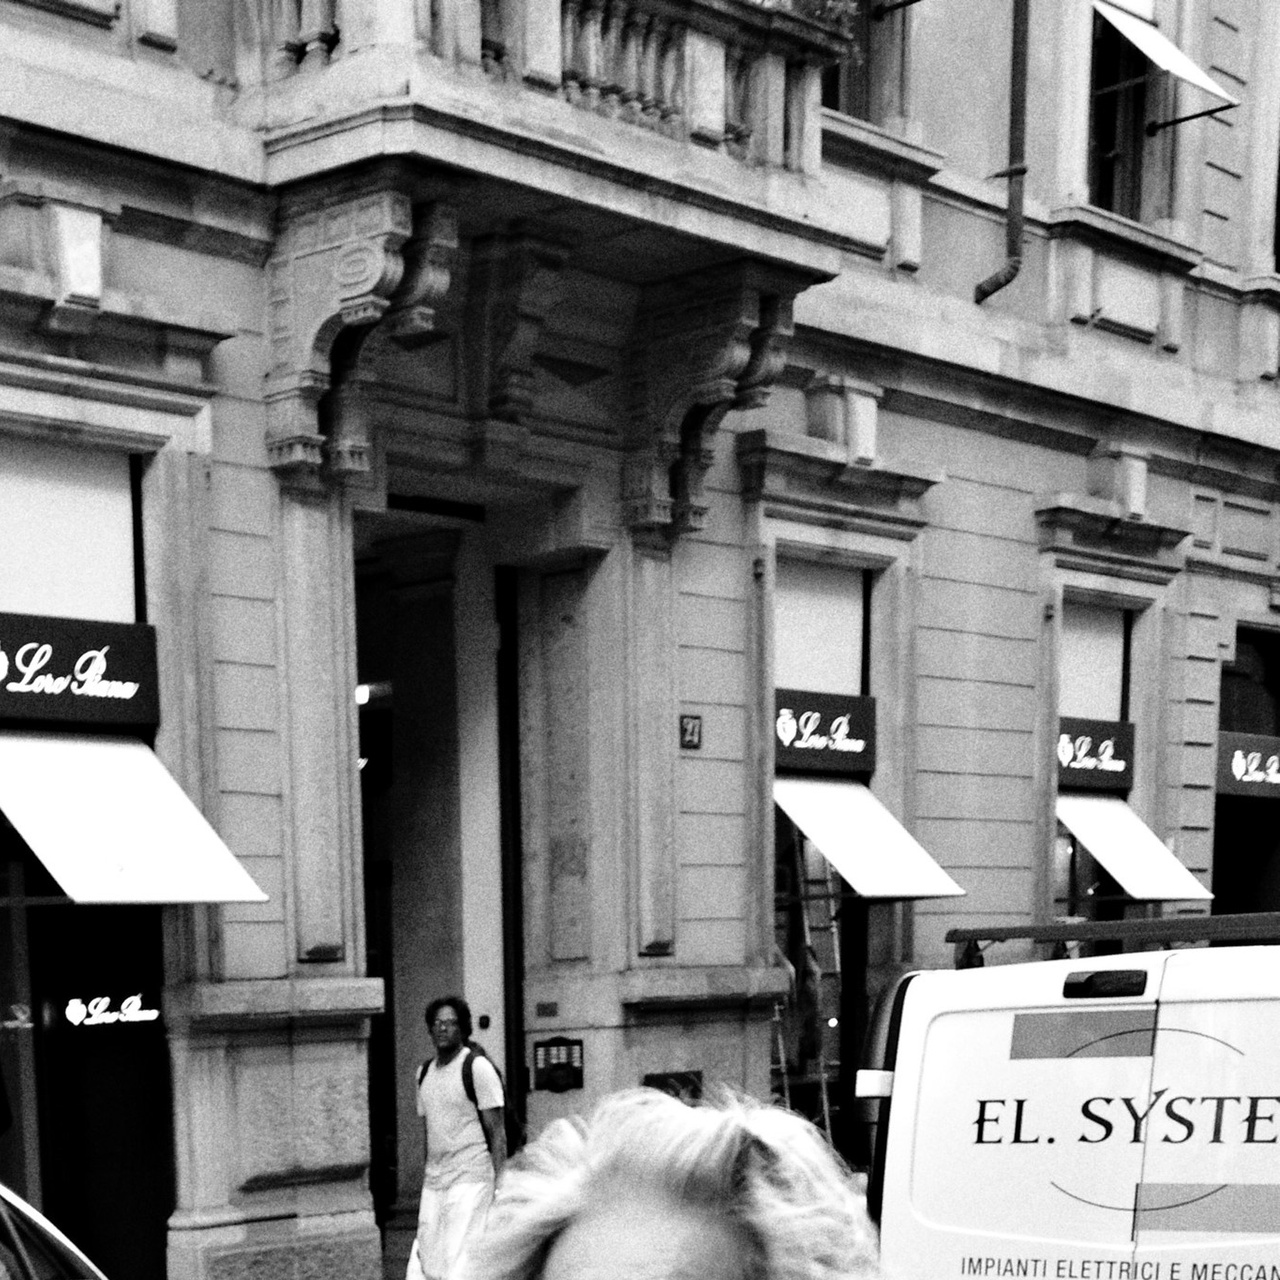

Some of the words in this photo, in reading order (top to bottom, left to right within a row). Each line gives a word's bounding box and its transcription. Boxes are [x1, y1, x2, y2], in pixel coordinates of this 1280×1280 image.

[6, 642, 71, 694] Loro
[973, 1098, 1056, 1145] EL.
[1077, 1087, 1280, 1145] SYSTE
[960, 1256, 1048, 1279] IMPIANTI
[1055, 1259, 1161, 1280] ELETTRICI
